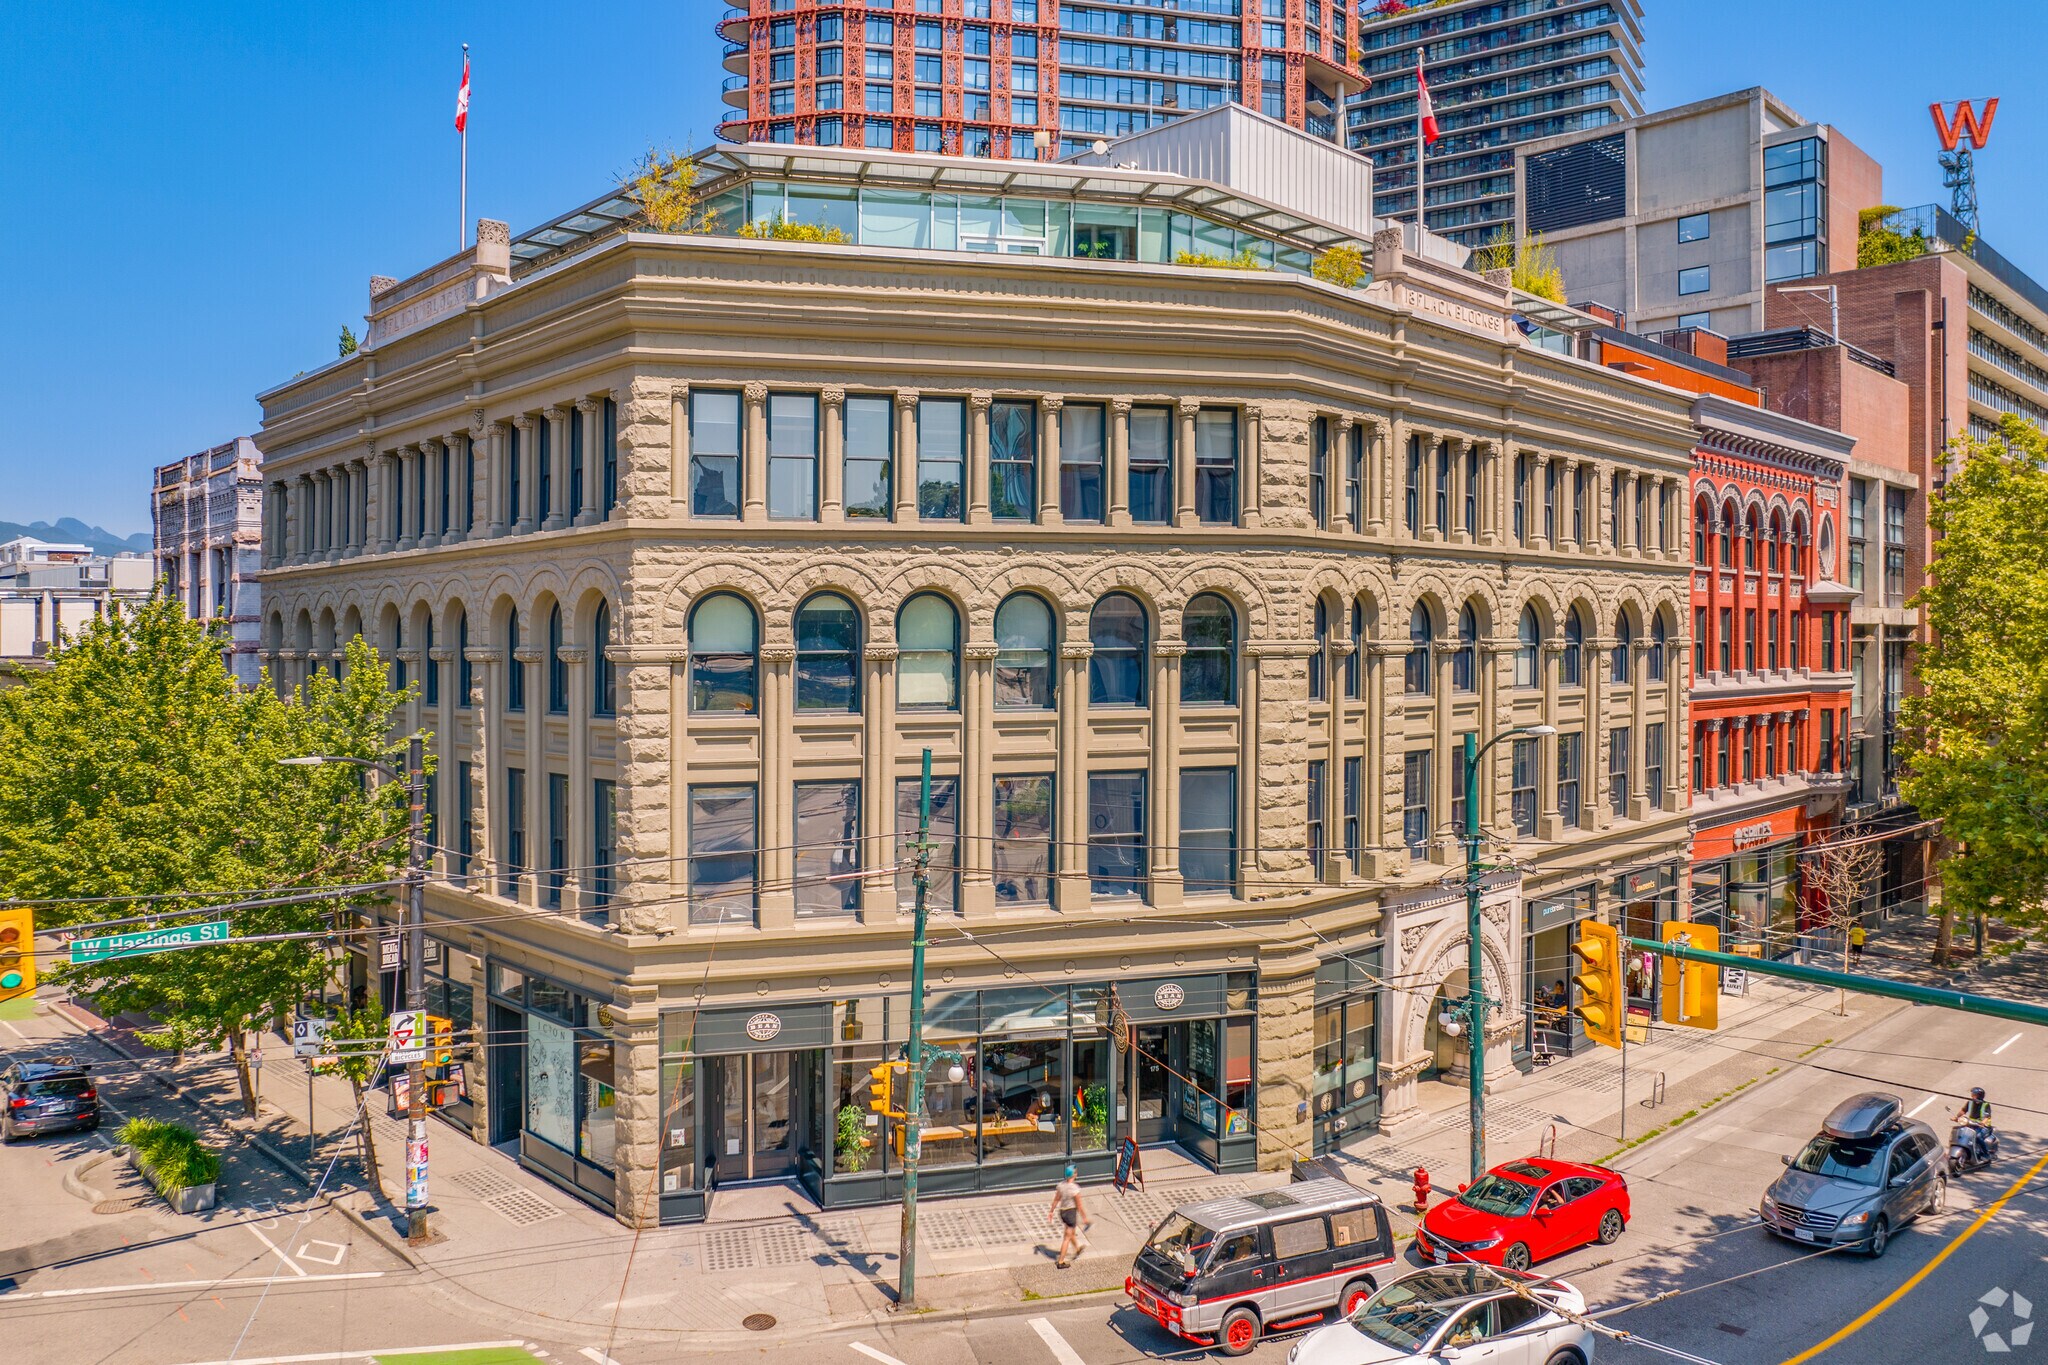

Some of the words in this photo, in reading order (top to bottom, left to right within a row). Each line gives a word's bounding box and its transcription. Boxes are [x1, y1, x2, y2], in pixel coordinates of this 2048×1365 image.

[1929, 98, 2000, 151] W
[81, 940, 101, 957] W
[109, 931, 192, 954] Hastings
[200, 925, 219, 940] St
[750, 1023, 778, 1031] BEAN
[1149, 1065, 1160, 1073] 175
